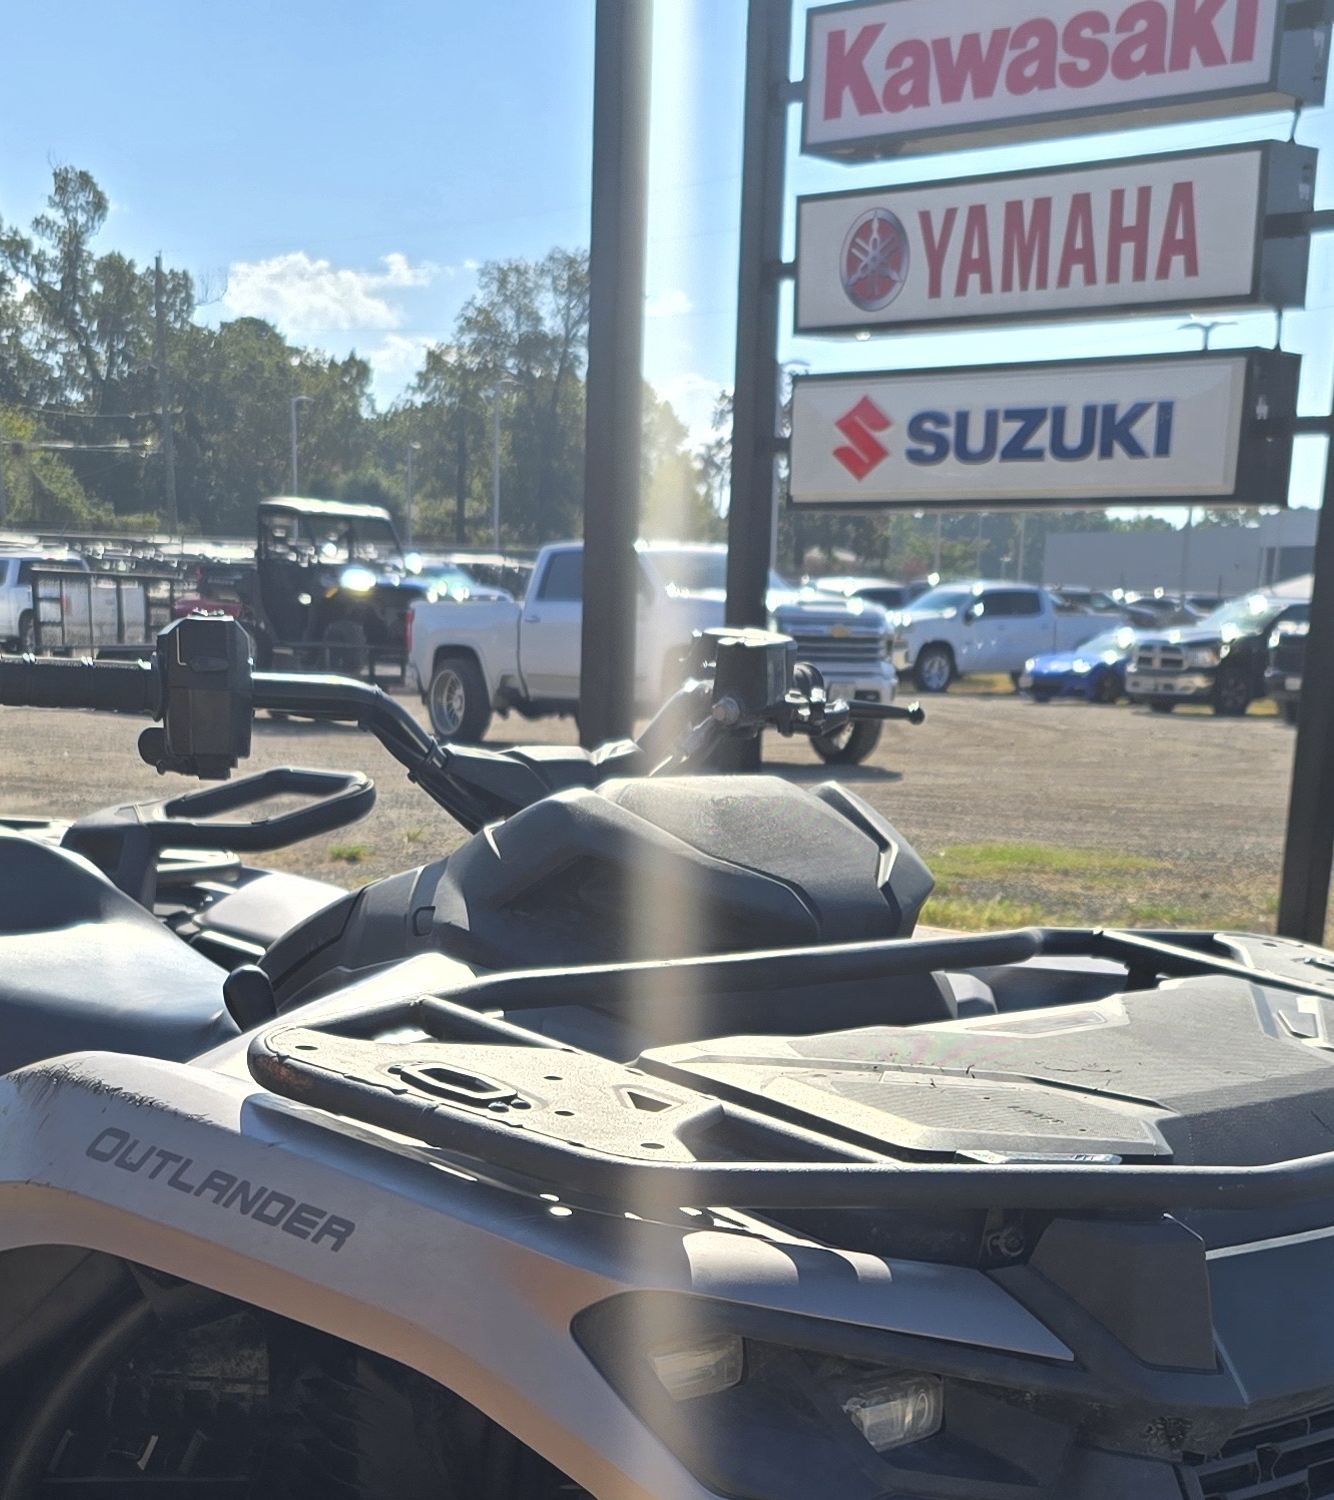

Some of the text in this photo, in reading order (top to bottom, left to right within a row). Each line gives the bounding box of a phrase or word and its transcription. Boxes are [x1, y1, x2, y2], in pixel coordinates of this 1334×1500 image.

[823, 0, 1260, 121] Kawasaki
[918, 181, 1199, 299] YAMAHA
[905, 400, 1175, 466] SUZUKI
[85, 1127, 356, 1252] OUTLANDER
